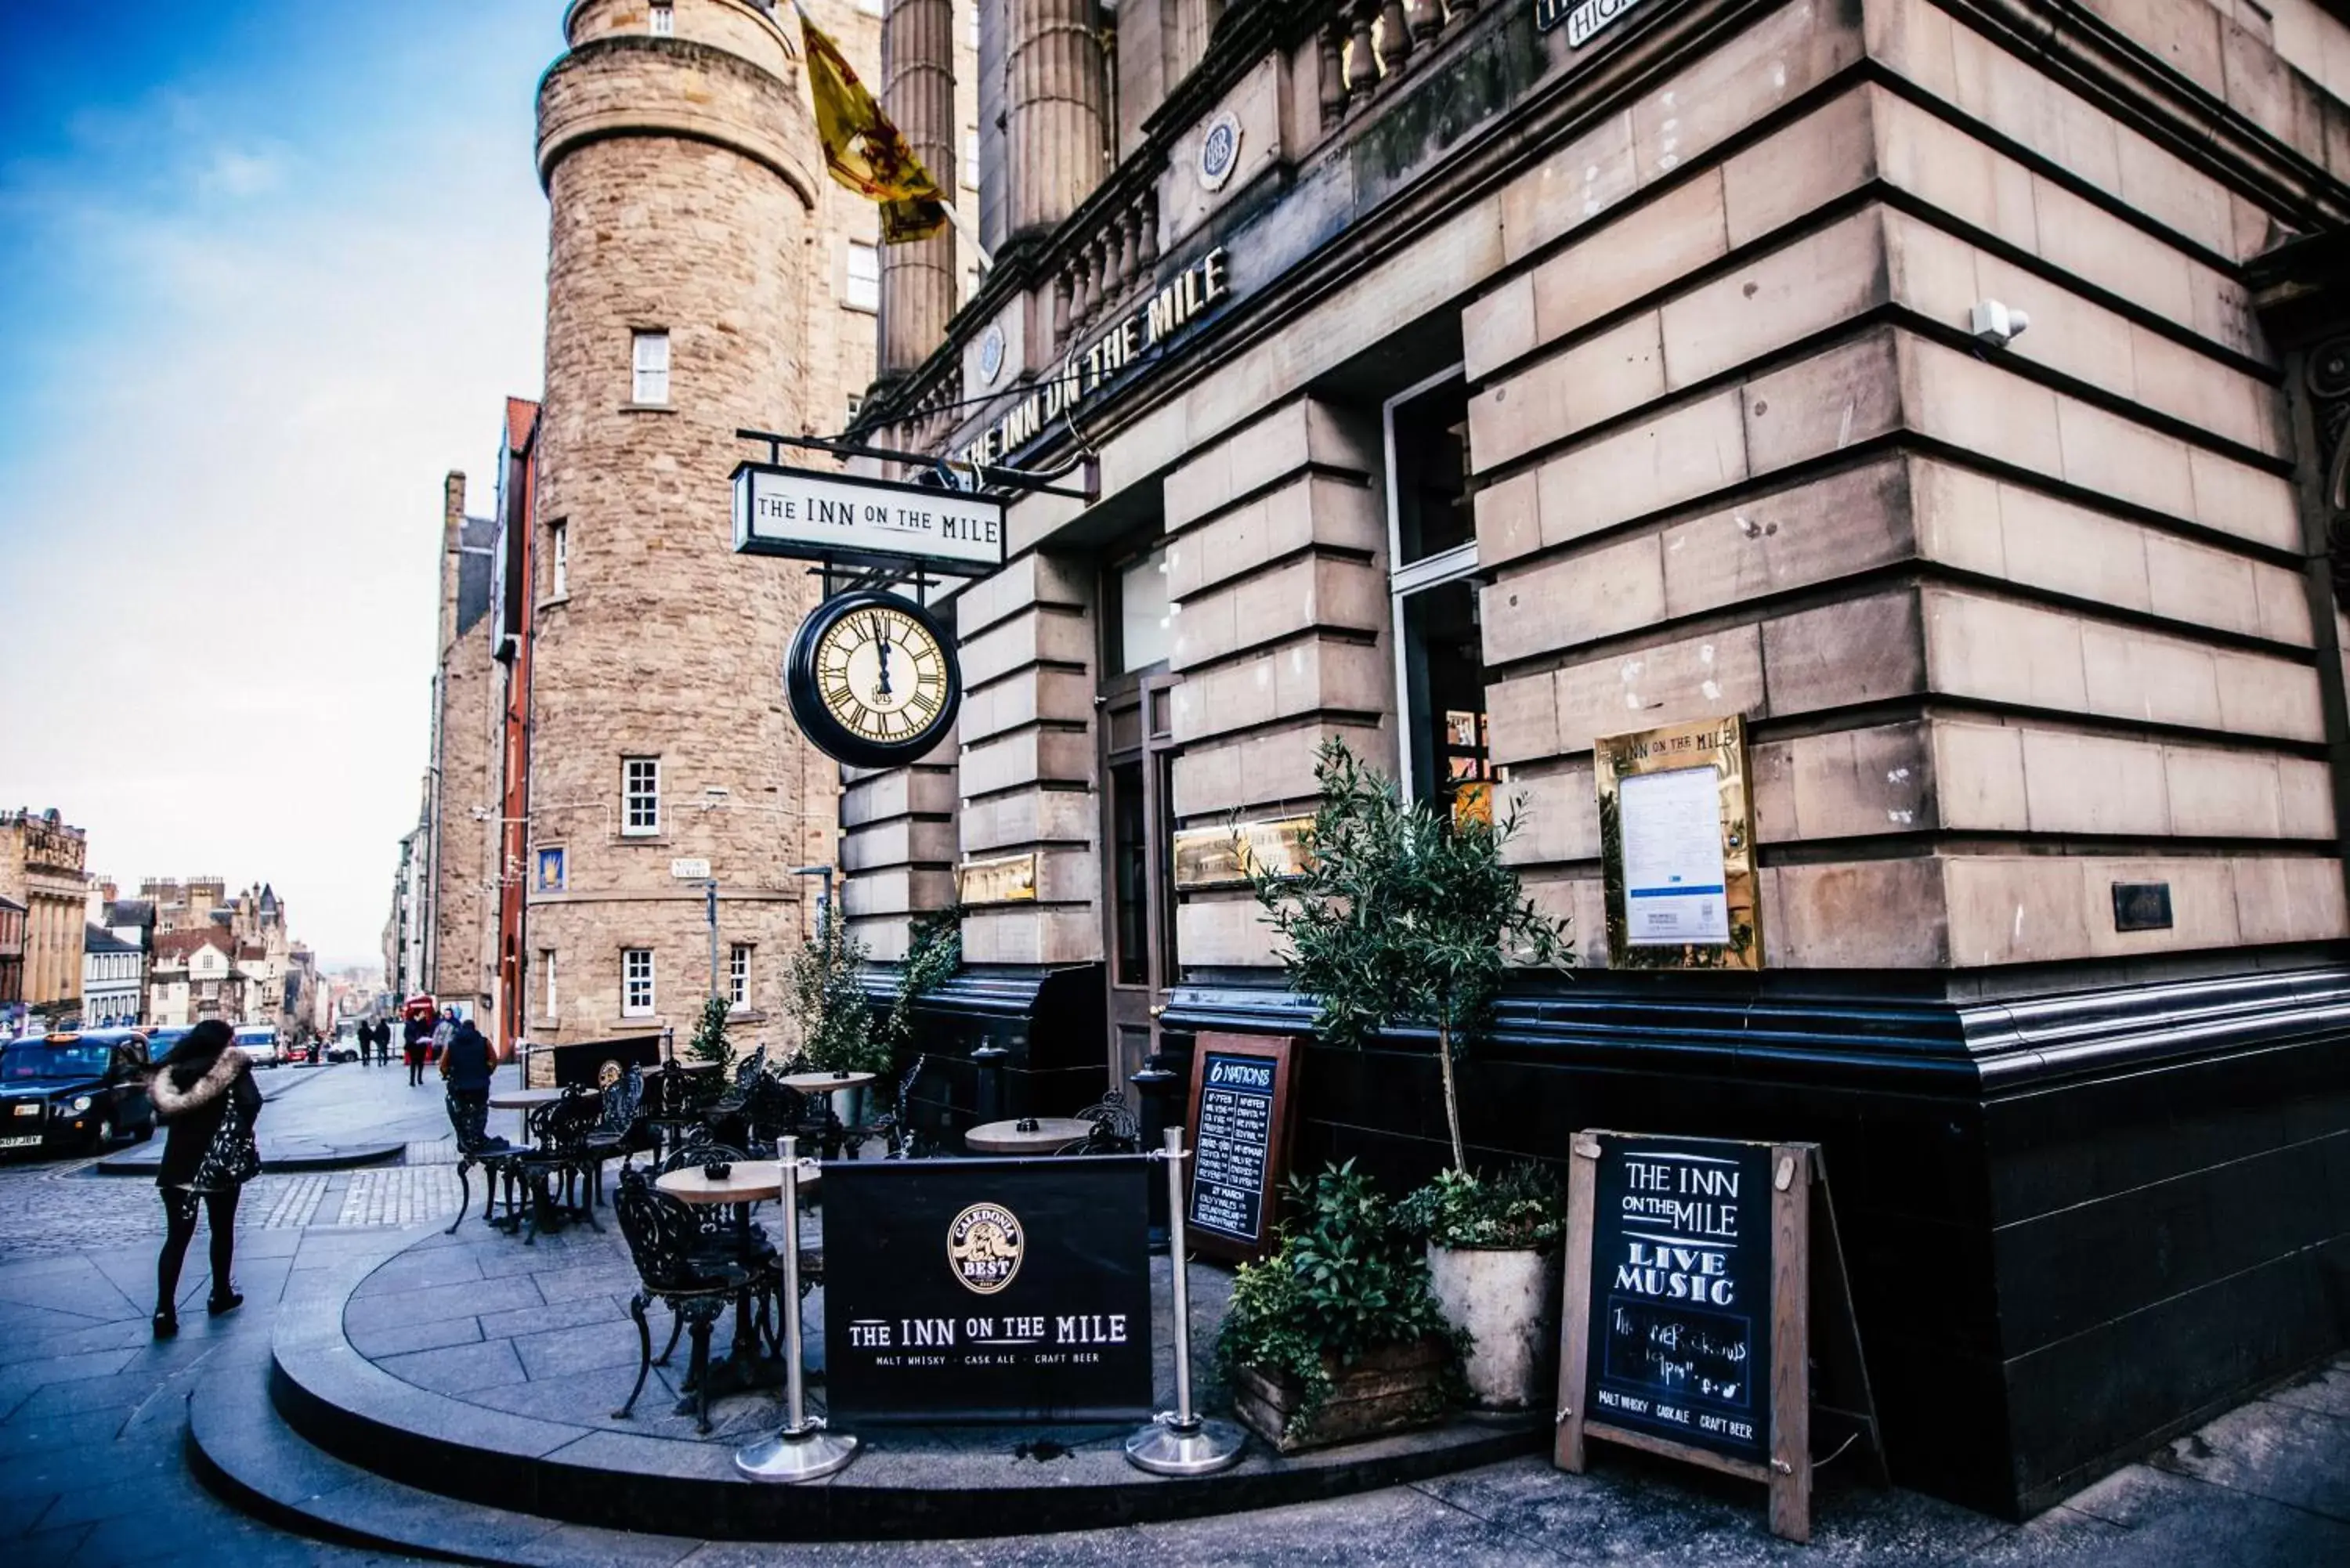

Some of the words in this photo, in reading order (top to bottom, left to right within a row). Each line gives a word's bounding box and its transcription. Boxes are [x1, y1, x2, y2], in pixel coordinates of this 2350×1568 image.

[1574, 0, 1628, 39] HIG
[1002, 393, 1041, 455] INN
[1086, 316, 1141, 390] THE
[1148, 245, 1231, 345] MILE
[758, 497, 796, 519] THE
[807, 498, 855, 526] INN
[865, 505, 888, 523] ON
[897, 509, 931, 529] THE
[942, 515, 998, 544] MILE
[1653, 739, 1666, 752] ON
[1671, 735, 1691, 750] THE
[1697, 729, 1734, 750] MILE
[1210, 1061, 1223, 1082] 6
[1223, 1065, 1271, 1086] NATIONS
[1625, 1162, 1670, 1191] THE
[1679, 1168, 1738, 1198] INN
[955, 1210, 1014, 1238] CALEDONIA
[1622, 1195, 1644, 1213] ON
[1644, 1198, 1676, 1216] THE
[1672, 1202, 1737, 1237] MILE
[964, 1260, 1010, 1276] BEST
[1629, 1243, 1726, 1276] LIVE
[1614, 1265, 1734, 1306] MUSIC
[849, 1325, 891, 1347] THE
[901, 1318, 956, 1346] INN
[966, 1317, 994, 1338] ON
[1003, 1316, 1045, 1337] THE
[1056, 1314, 1128, 1345] MILE
[877, 1356, 901, 1366] MALT
[908, 1356, 945, 1365] WHISKY
[964, 1355, 991, 1365] CASK
[997, 1355, 1016, 1364] ALE
[1035, 1354, 1065, 1364] CRAFT
[1073, 1353, 1100, 1363] BEER
[1599, 1390, 1620, 1407] MALT
[1699, 1414, 1728, 1433] CRAFT
[1729, 1421, 1752, 1440] BEER
